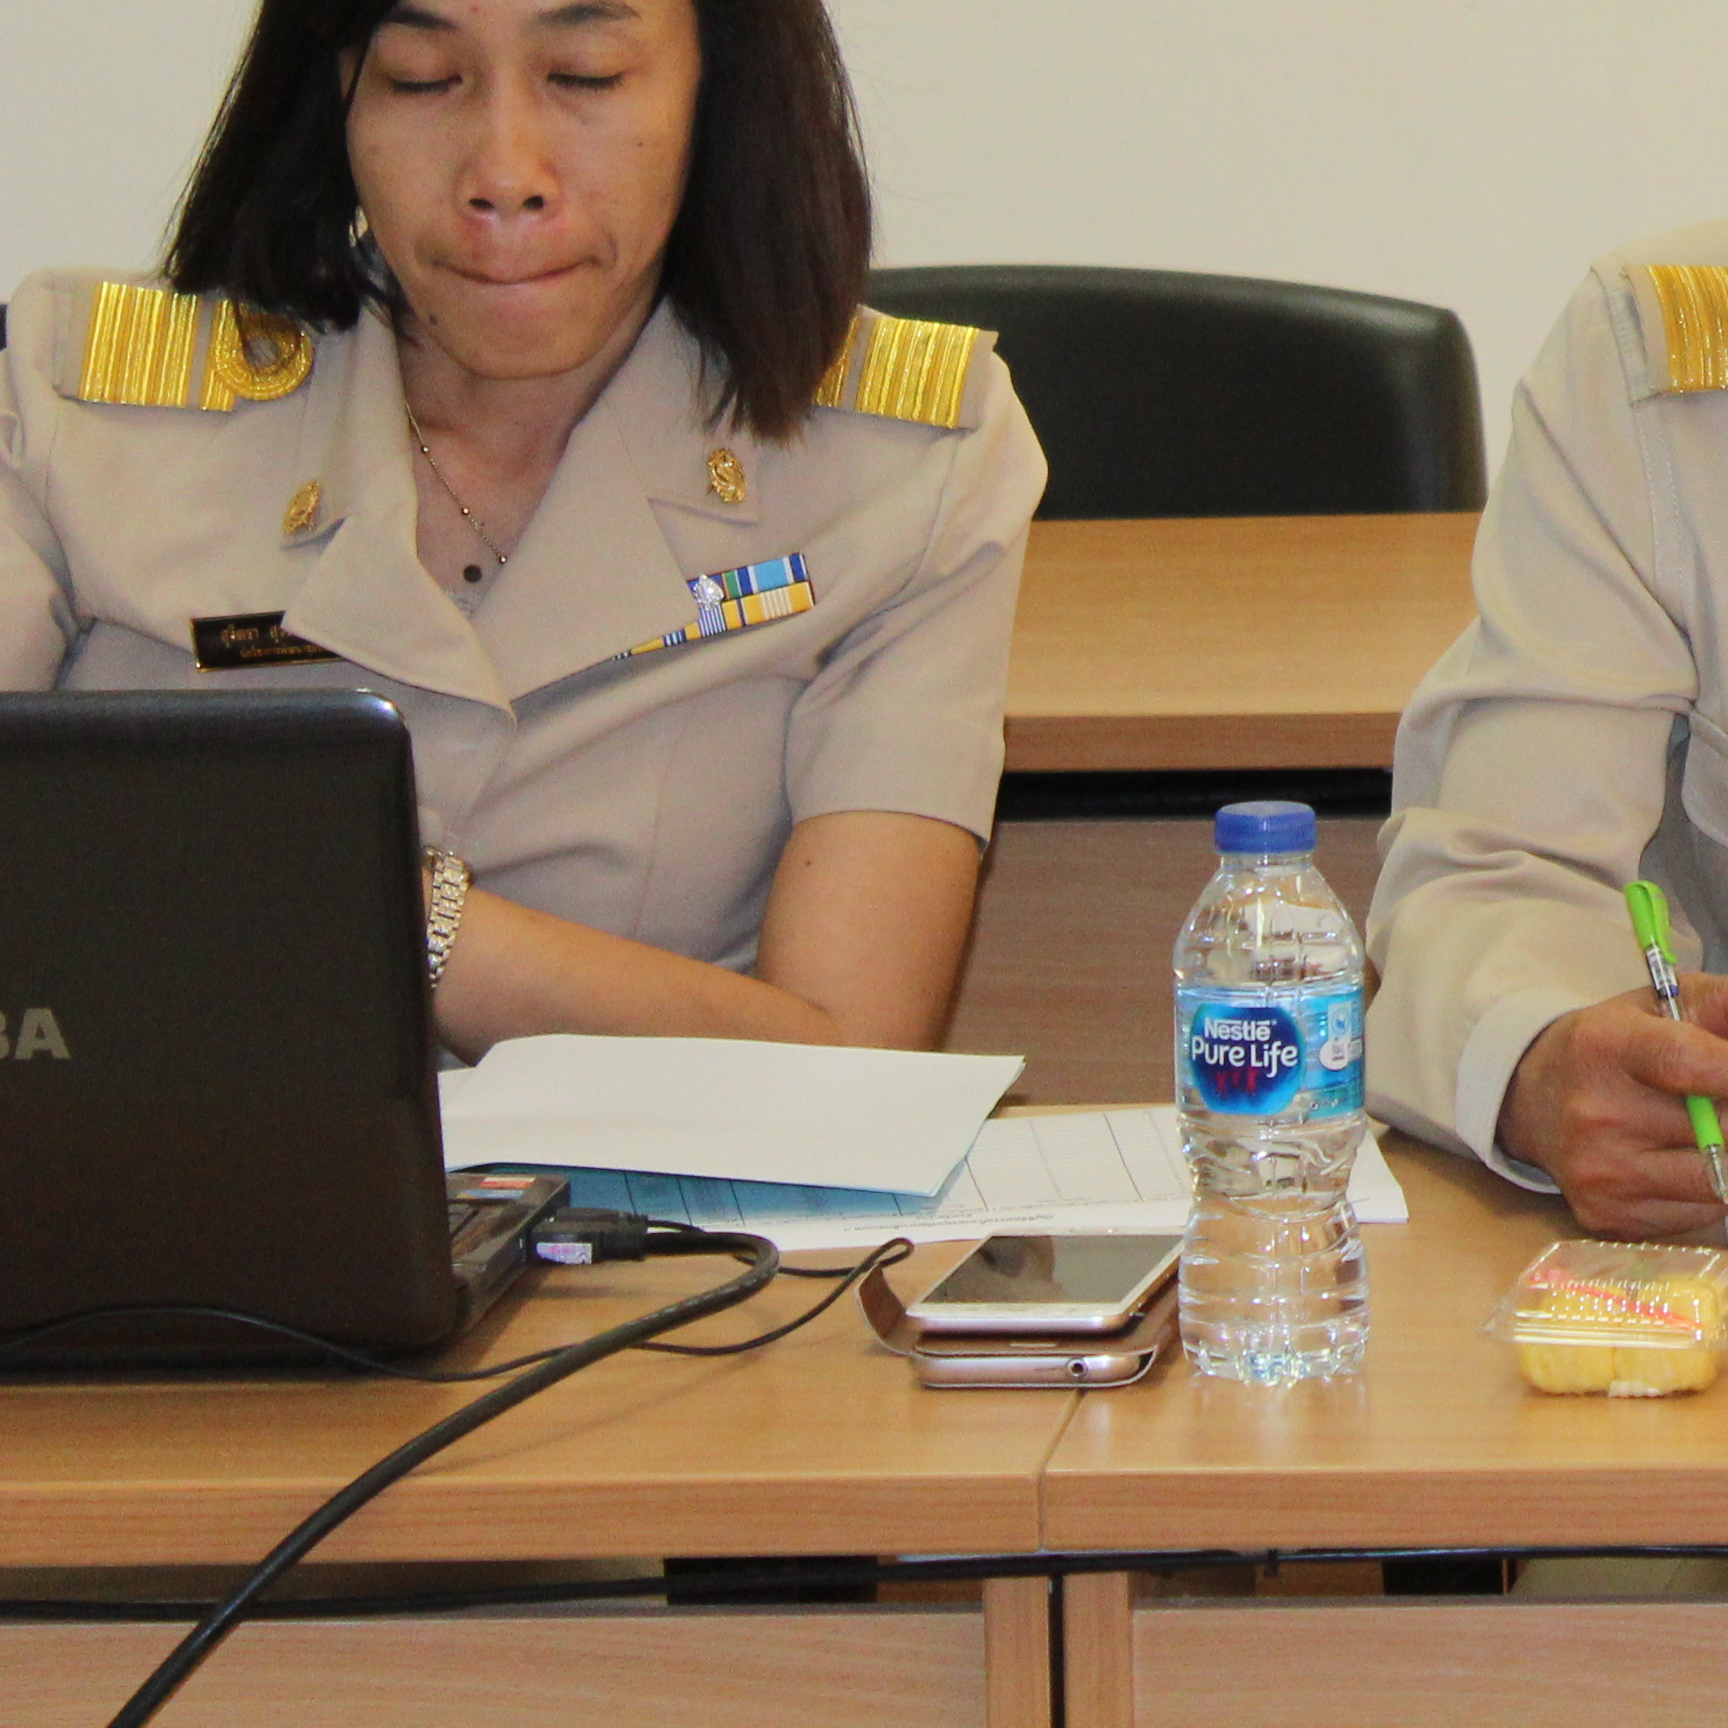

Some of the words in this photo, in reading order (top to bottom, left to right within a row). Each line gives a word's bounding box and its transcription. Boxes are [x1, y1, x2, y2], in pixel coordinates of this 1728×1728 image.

[0, 1007, 72, 1061] A
[1191, 1036, 1245, 1067] Pure
[1250, 1040, 1299, 1078] Life
